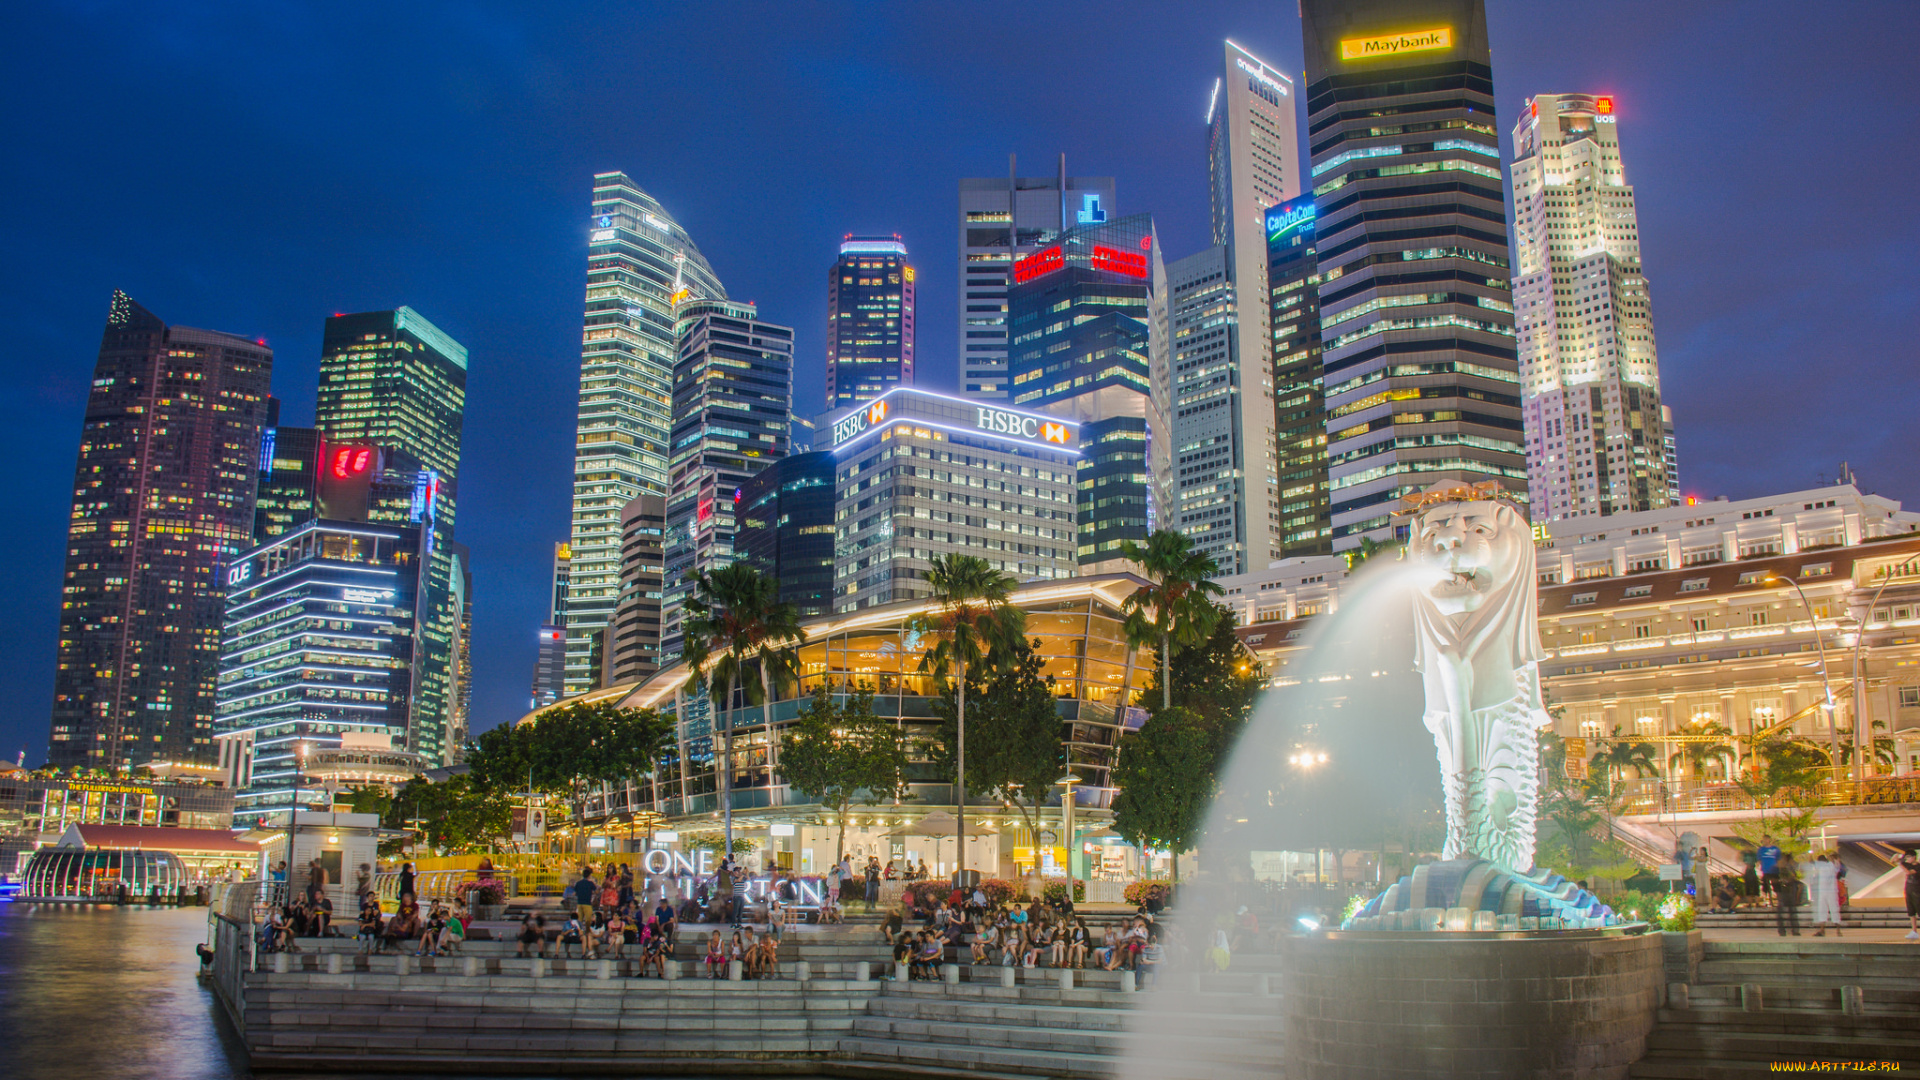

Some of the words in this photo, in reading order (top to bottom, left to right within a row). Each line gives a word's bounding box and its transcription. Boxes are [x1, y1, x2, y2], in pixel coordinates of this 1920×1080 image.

[1365, 34, 1439, 52] Maybank
[1595, 115, 1615, 123] UOB
[1268, 204, 1316, 232] CapitaCom
[1297, 222, 1314, 233] Trust
[1014, 246, 1061, 272] STRAITS
[1094, 246, 1147, 266] STRAITS
[1015, 257, 1064, 283] TRADING
[1091, 257, 1147, 279] TRADING
[833, 409, 868, 446] HSBC
[976, 407, 1037, 438] HSBC
[228, 562, 251, 585] OUE
[68, 783, 82, 791] THE
[644, 849, 714, 875] ONE
